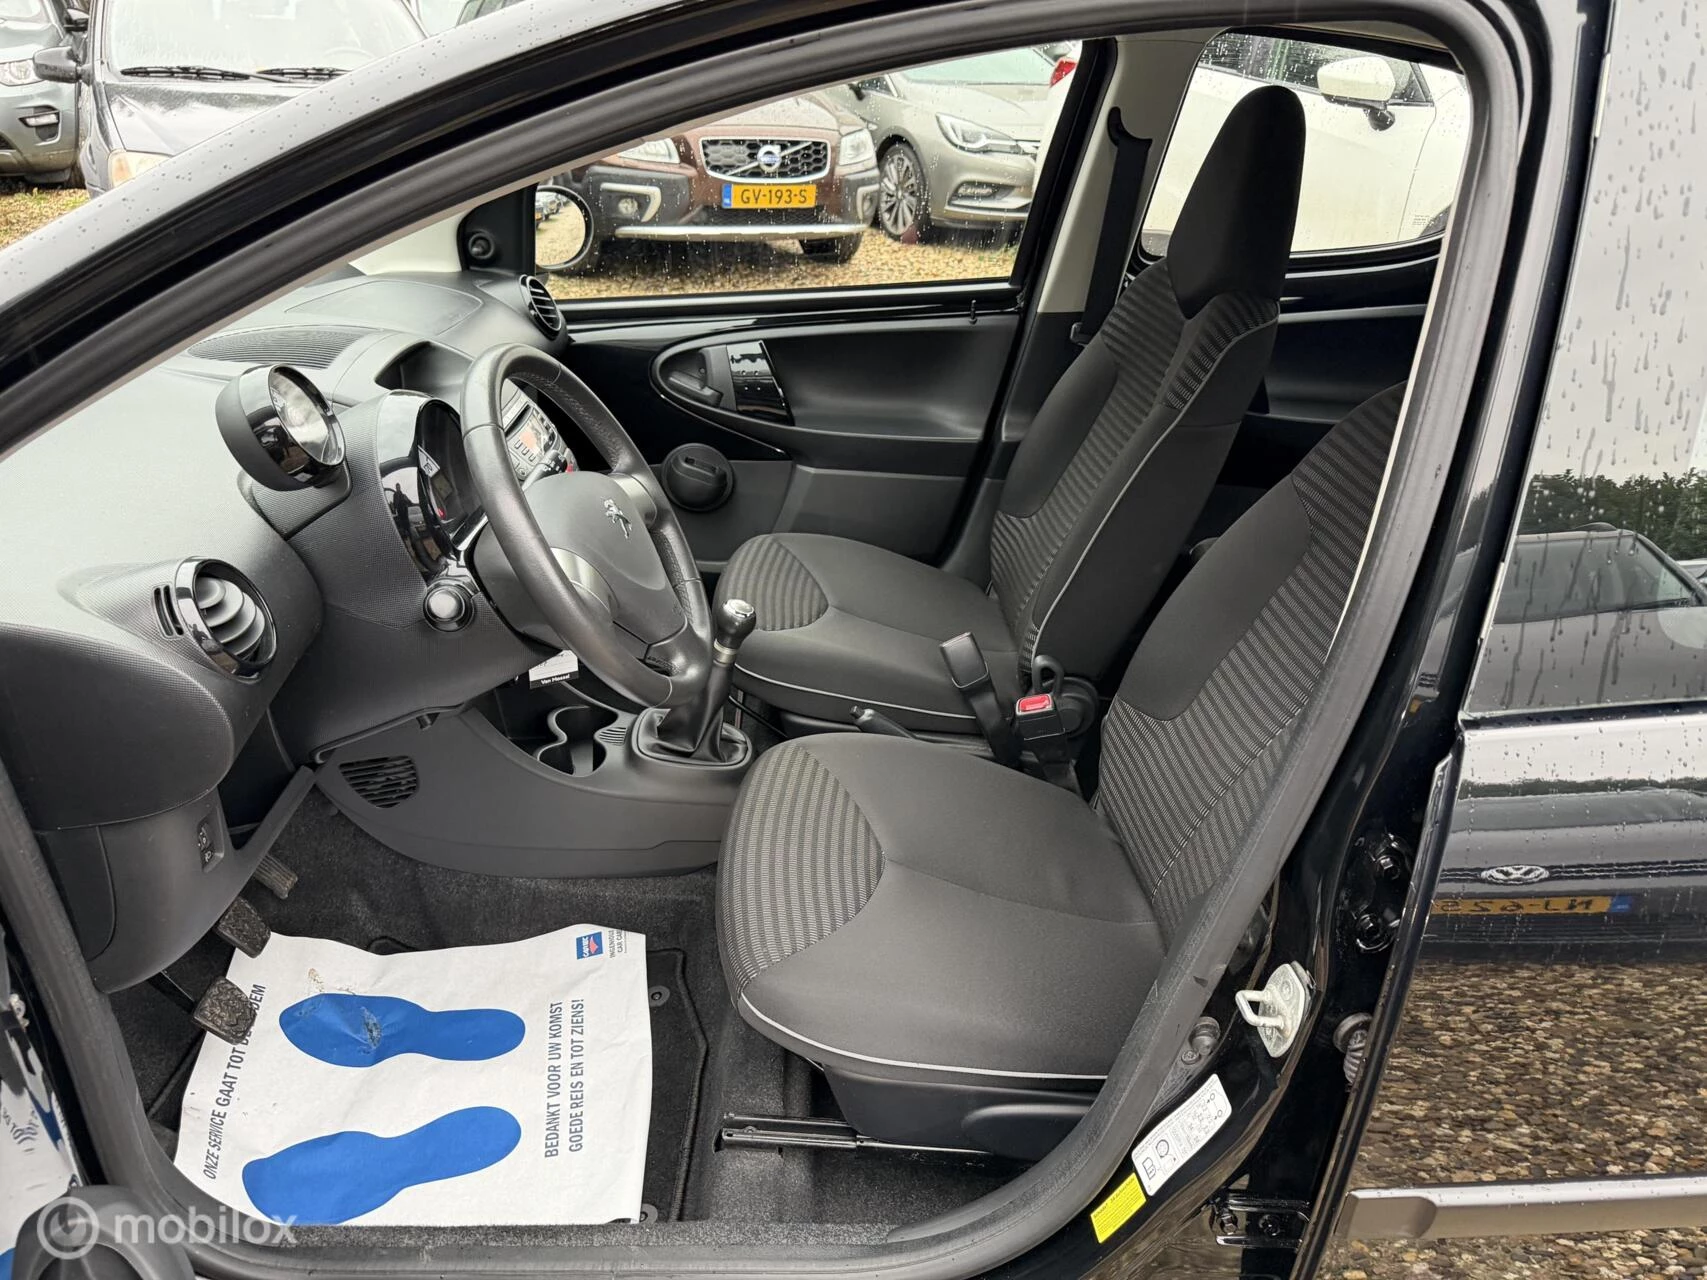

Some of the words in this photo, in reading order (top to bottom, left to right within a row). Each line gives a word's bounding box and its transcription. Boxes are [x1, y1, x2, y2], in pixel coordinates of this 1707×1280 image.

[740, 189, 807, 204] GV-193-S
[548, 1001, 563, 1039] KOMST
[570, 999, 584, 1036] ZIENS!
[226, 1047, 246, 1069] TOT
[547, 1042, 562, 1060] UW
[570, 1038, 584, 1060] TOT
[546, 1064, 561, 1099] VOOR
[570, 1062, 584, 1077] EN
[215, 1072, 238, 1107] GAAT
[569, 1081, 584, 1109] REIS
[208, 1109, 227, 1151] SERVICE
[544, 1102, 560, 1158] BEDANKT
[568, 1111, 584, 1152] GOEDE
[203, 1149, 219, 1180] ONZE
